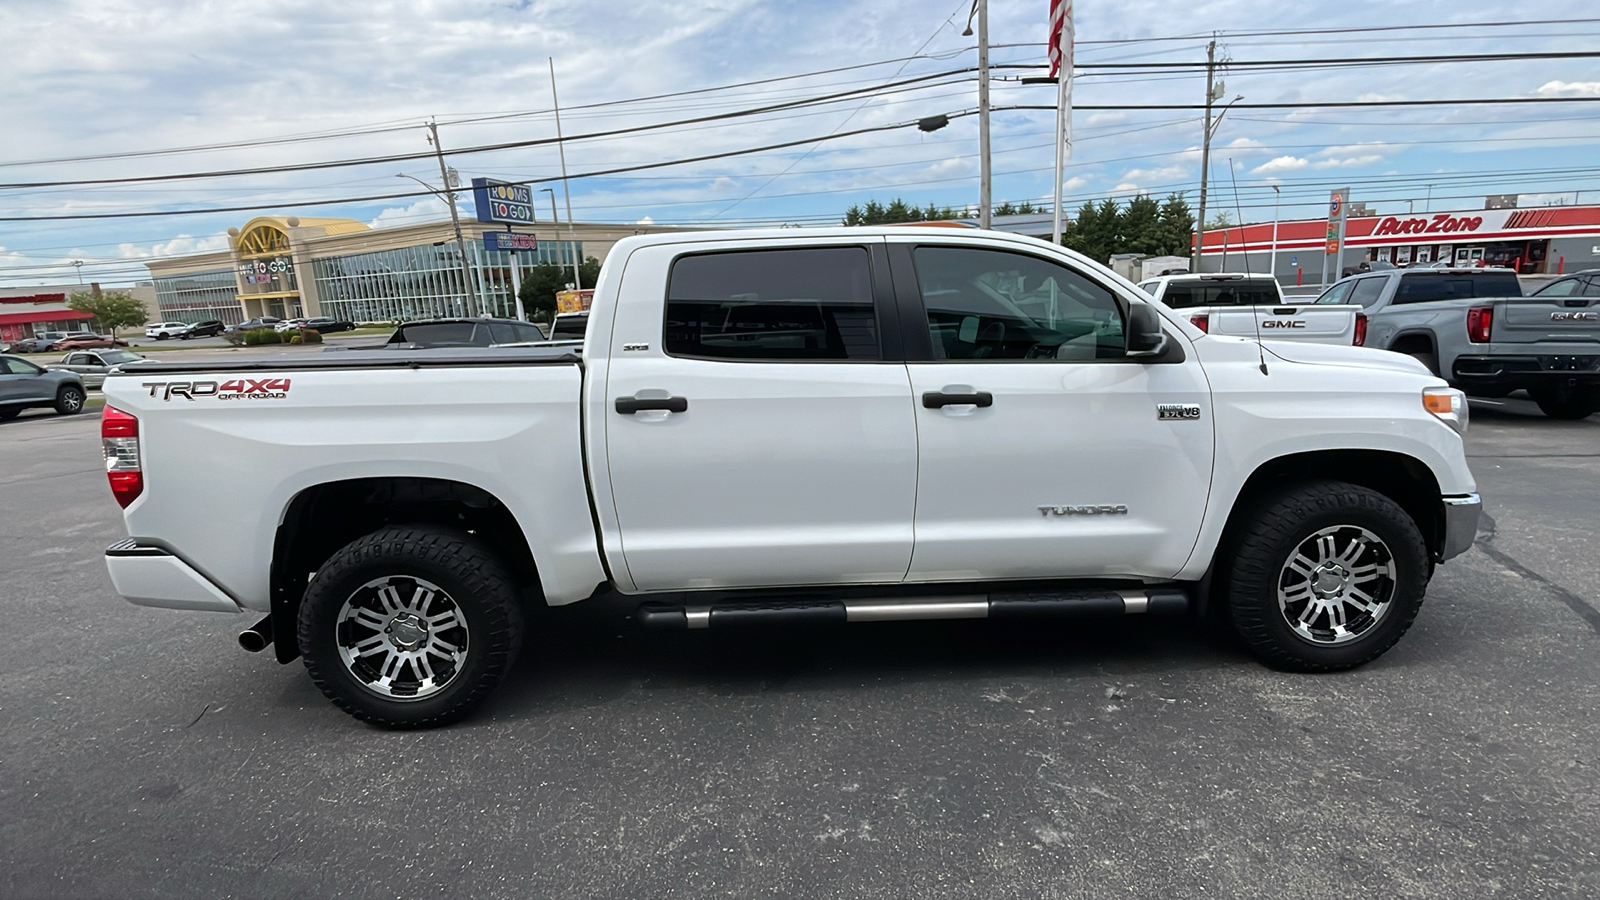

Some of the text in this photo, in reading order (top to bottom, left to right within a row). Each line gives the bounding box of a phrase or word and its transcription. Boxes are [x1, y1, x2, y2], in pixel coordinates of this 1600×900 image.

[492, 186, 528, 202] ROOMS
[493, 203, 525, 219] TO GO
[1374, 214, 1483, 236] AutoZone
[512, 234, 536, 249] KIDS
[270, 261, 286, 272] GO
[1551, 311, 1598, 321] GMC
[1262, 320, 1306, 329] GMC
[142, 381, 219, 401] TRD
[218, 392, 287, 401] OFF ROAD
[1183, 407, 1200, 418] V8
[1037, 504, 1129, 517] TUNDRA
